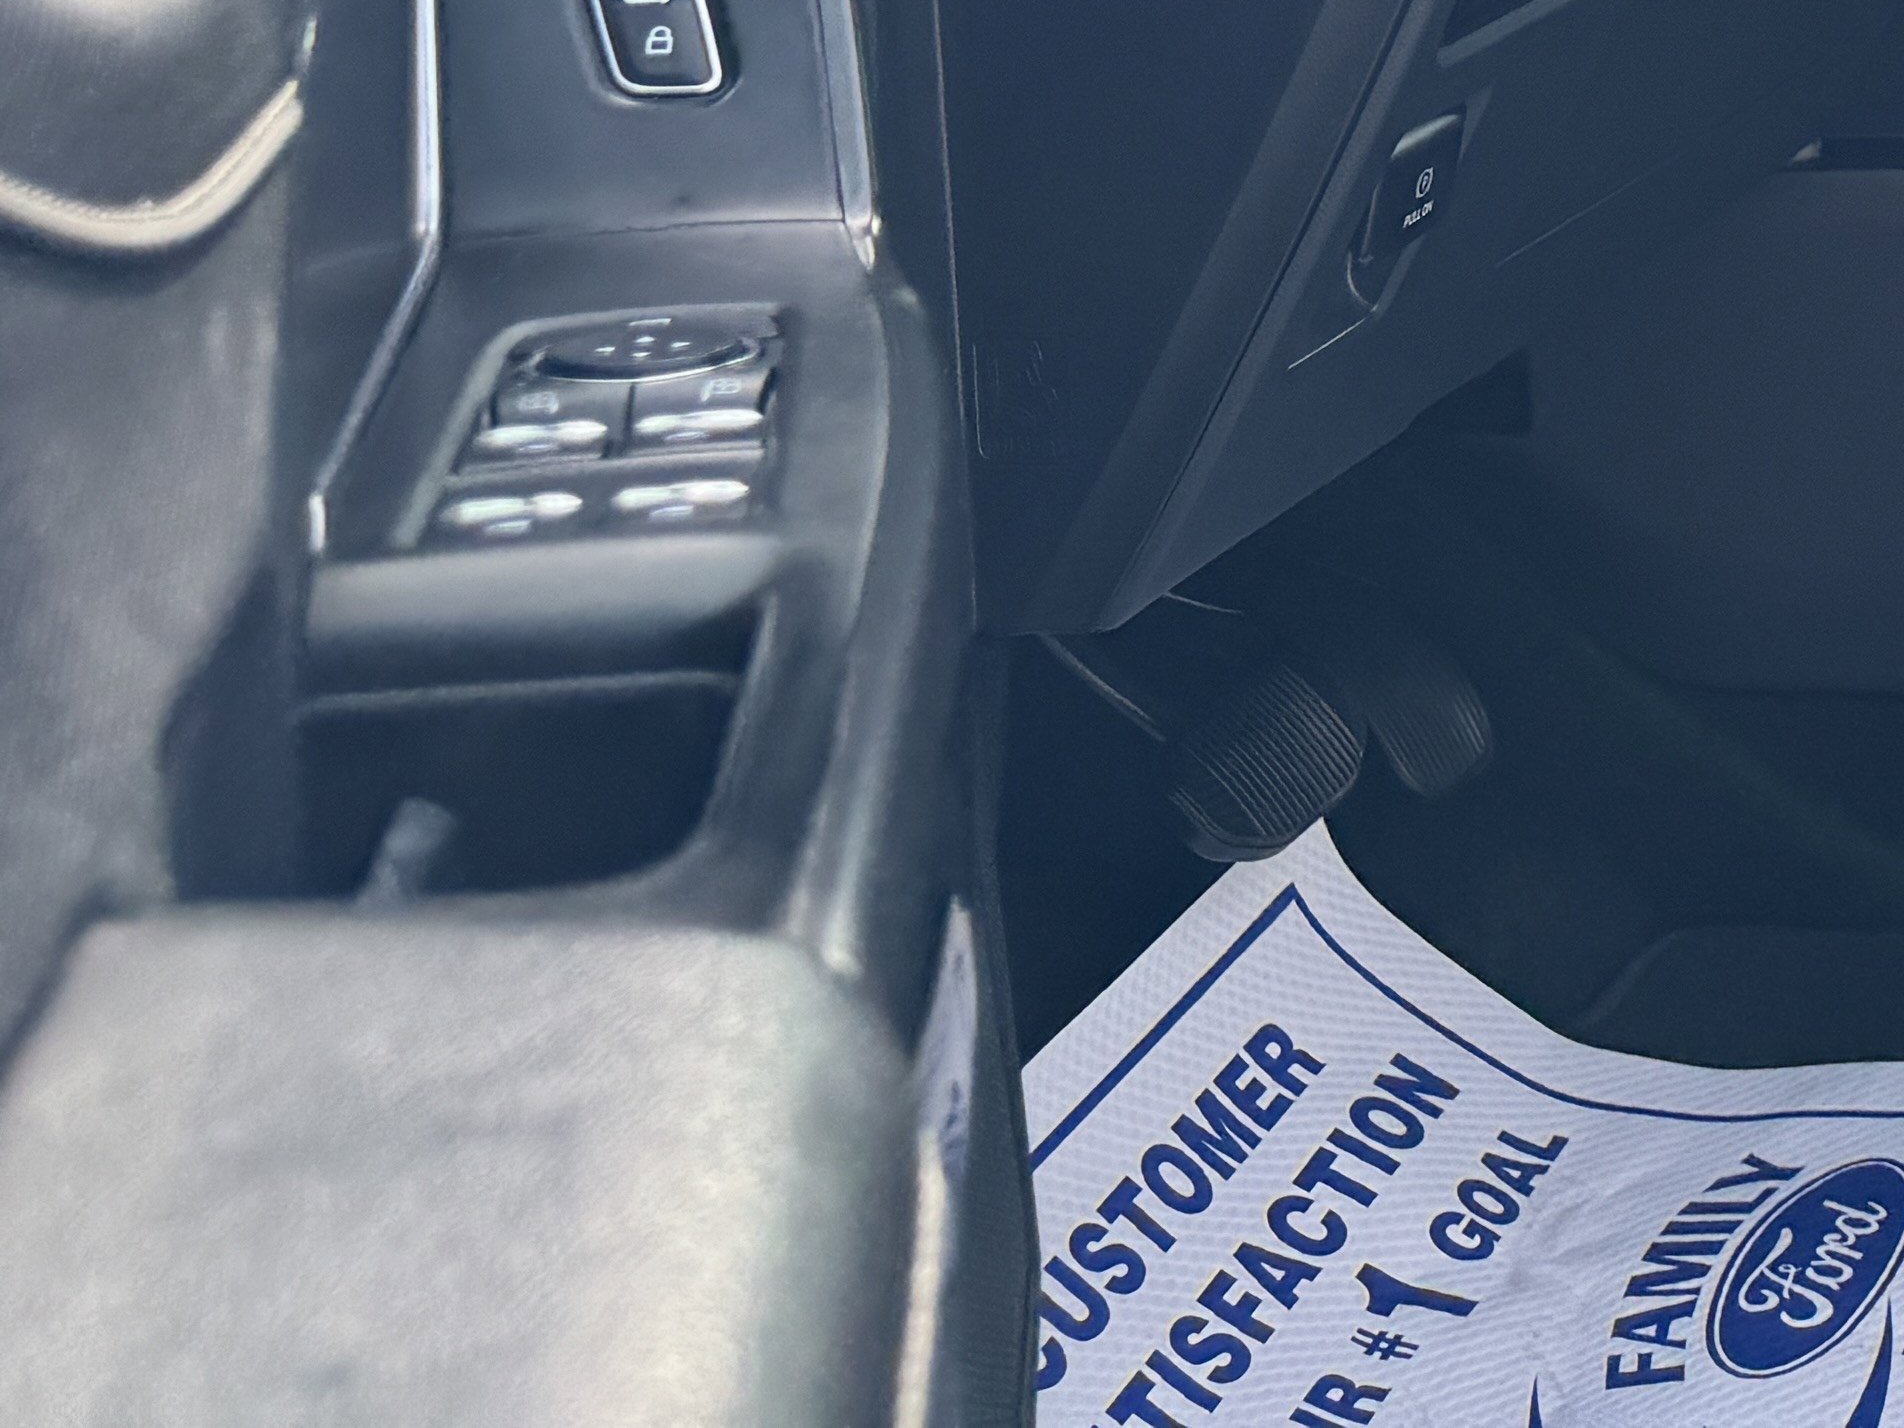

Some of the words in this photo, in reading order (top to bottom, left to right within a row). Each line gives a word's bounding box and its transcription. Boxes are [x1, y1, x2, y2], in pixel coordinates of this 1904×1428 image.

[1093, 1052, 1460, 1428] TISFACTION
[1428, 1130, 1569, 1260] GOAL
[1605, 1153, 1804, 1390] FAMILY
[1738, 1199, 1888, 1329] Ford
